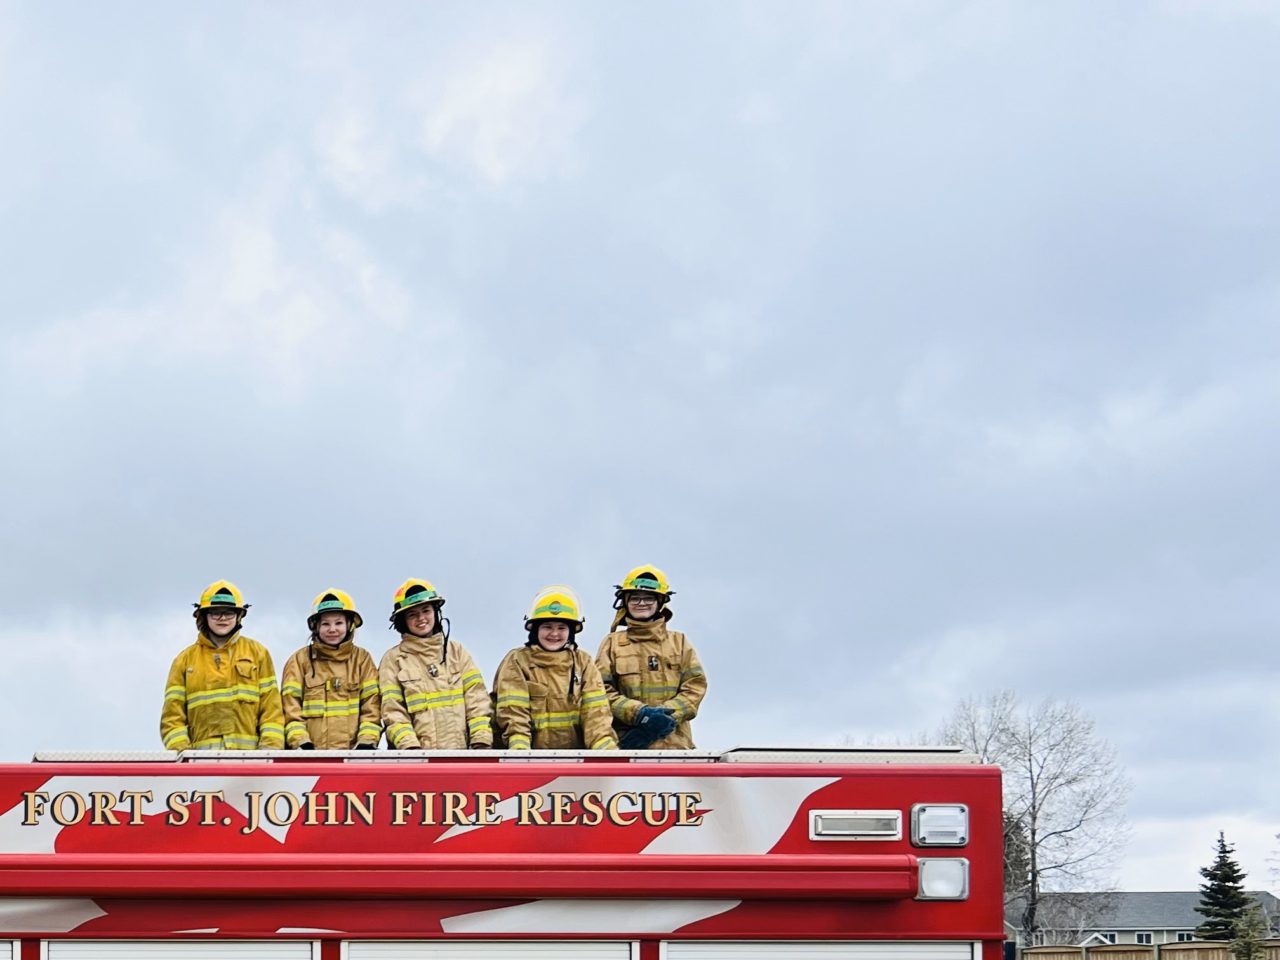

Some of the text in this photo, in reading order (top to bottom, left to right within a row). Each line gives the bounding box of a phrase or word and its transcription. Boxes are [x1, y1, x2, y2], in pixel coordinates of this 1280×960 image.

[21, 790, 704, 835] FORT ST. JOHN FIRE RESCUE
